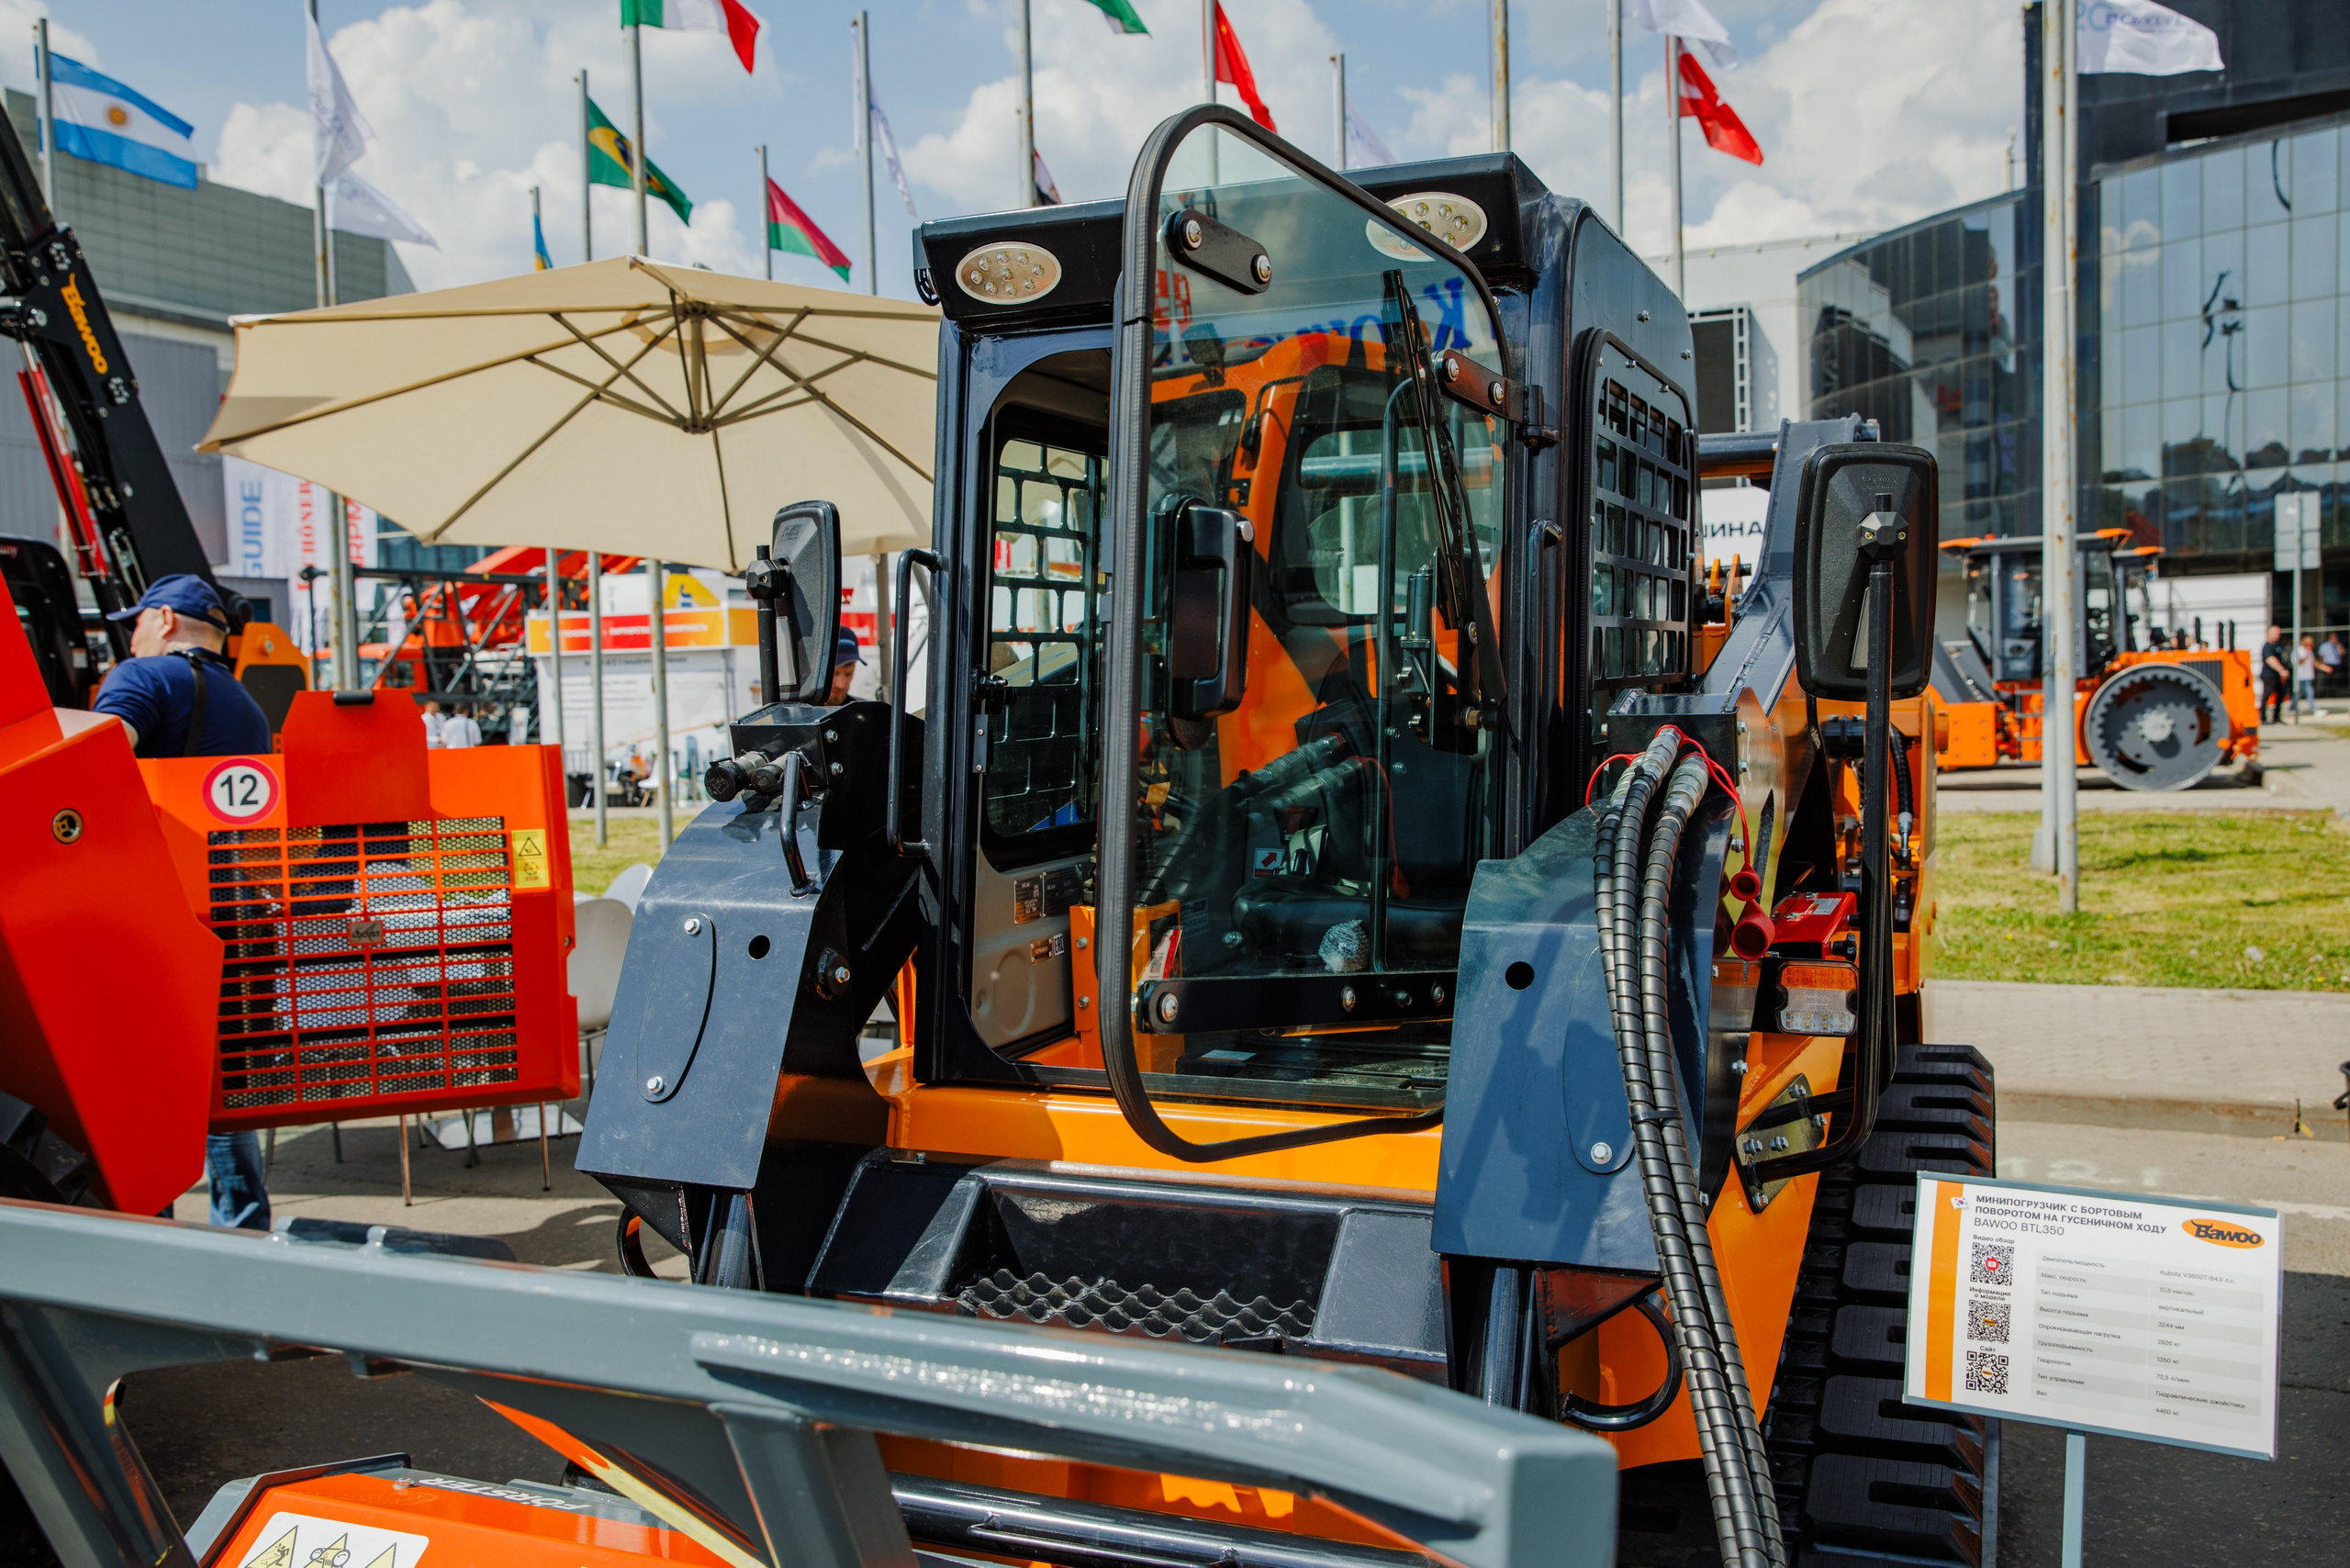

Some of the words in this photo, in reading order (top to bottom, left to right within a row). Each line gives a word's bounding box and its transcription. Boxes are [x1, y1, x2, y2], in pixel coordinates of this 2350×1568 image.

[61, 273, 108, 375] Bawoo
[240, 480, 263, 578] GUIDE
[220, 774, 259, 806] 12
[1975, 1194, 2067, 1212] МИНИПОГРУЗЧИК
[2070, 1204, 2078, 1213] С
[2080, 1205, 2143, 1220] БОРТОВЫМ
[1974, 1217, 2018, 1230] BAWOO
[2020, 1222, 2065, 1236] BTL350
[1975, 1205, 2041, 1220] ПОВОРОТОМ
[2043, 1212, 2058, 1222] НА
[2061, 1215, 2133, 1230] ГУСЕНИЧНОМ
[2136, 1223, 2167, 1234] ХОДУ
[1973, 1234, 1994, 1242] Видео
[2190, 1219, 2262, 1245] Bawoo
[2042, 1255, 2106, 1268] Двигатель/мощность
[2160, 1270, 2181, 1278] Kubota
[1969, 1286, 2011, 1296] Информация
[2039, 1305, 2062, 1315] Высота
[2158, 1305, 2204, 1315] вертикальный
[2038, 1323, 2092, 1335] Опрокидывающая
[2093, 1331, 2121, 1339] нагрузка
[2037, 1357, 2072, 1367] Гидропоток
[2048, 1376, 2085, 1385] управления
[2155, 1390, 2209, 1404] Гидравлические
[2210, 1398, 2246, 1408] джойстики
[419, 1478, 592, 1511] FÖRSTER
